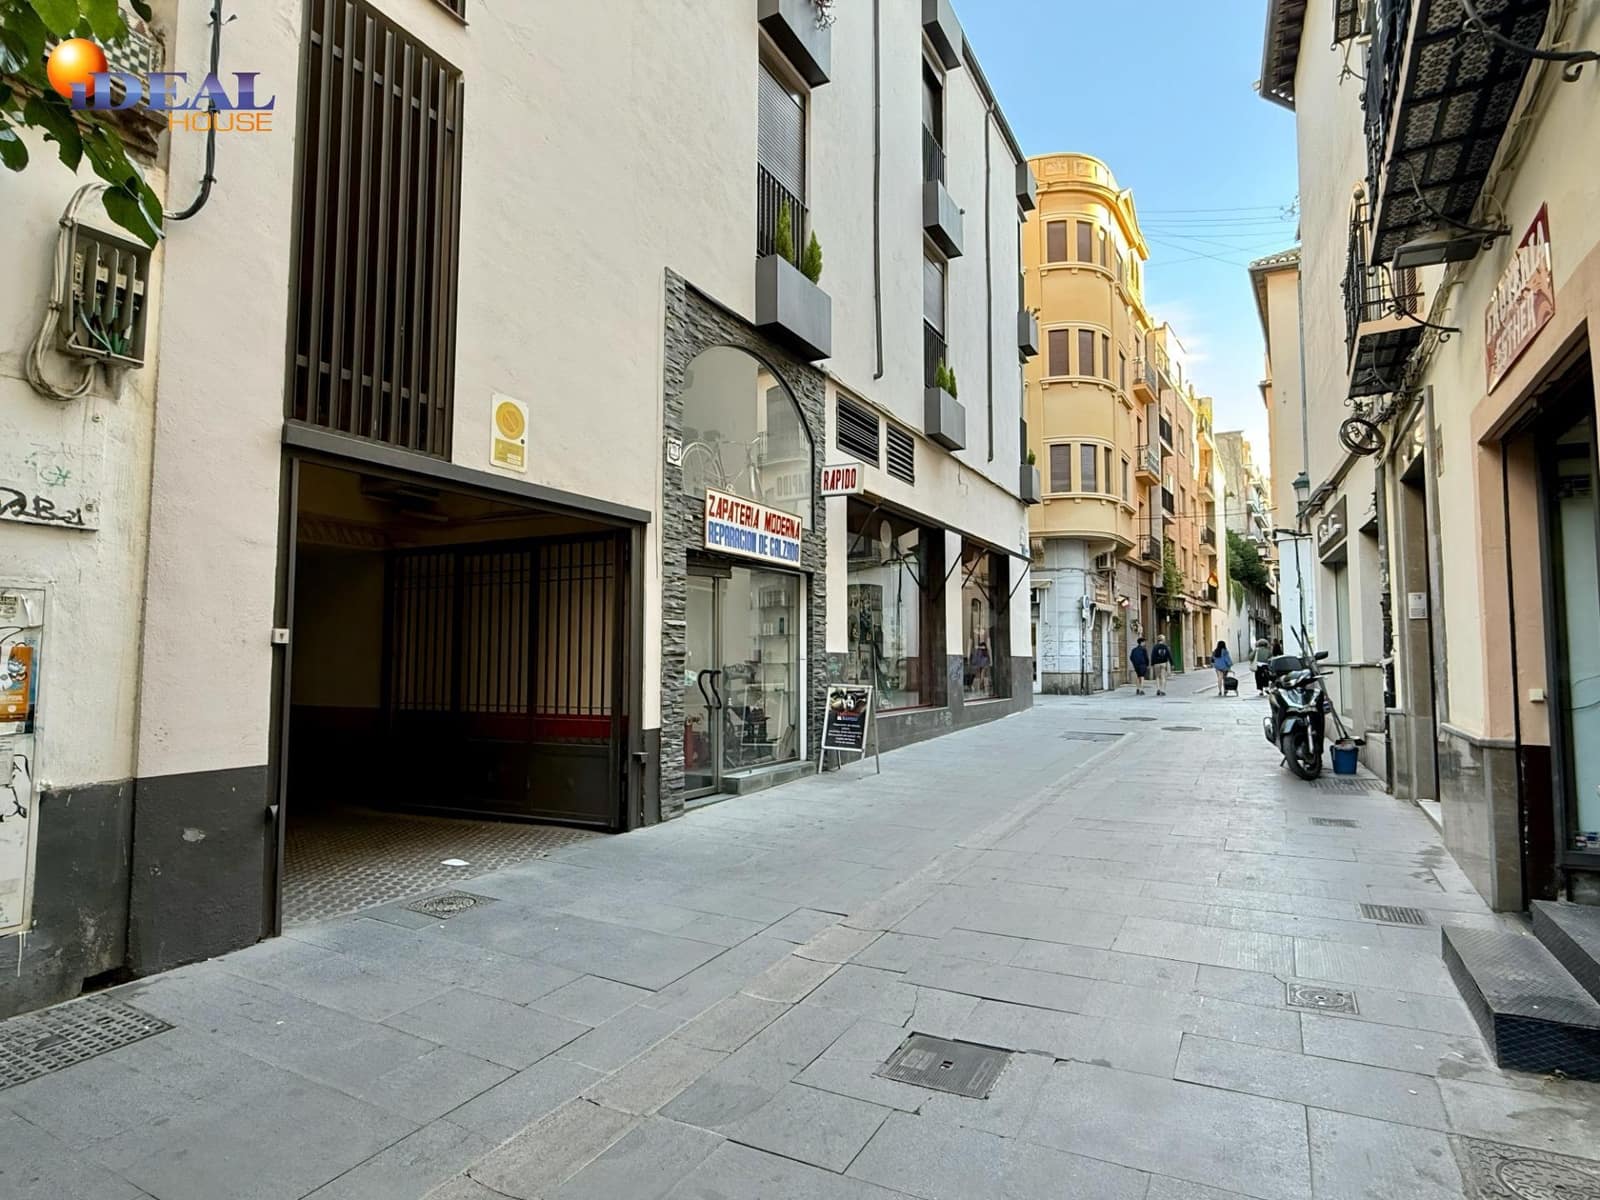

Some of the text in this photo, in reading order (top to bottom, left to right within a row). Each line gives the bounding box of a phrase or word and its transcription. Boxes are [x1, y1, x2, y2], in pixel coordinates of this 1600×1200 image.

[823, 468, 857, 491] RAPIDO
[709, 495, 801, 541] ZAPATERIA MODERNA
[708, 521, 800, 563] REPARACION DE CALZADO
